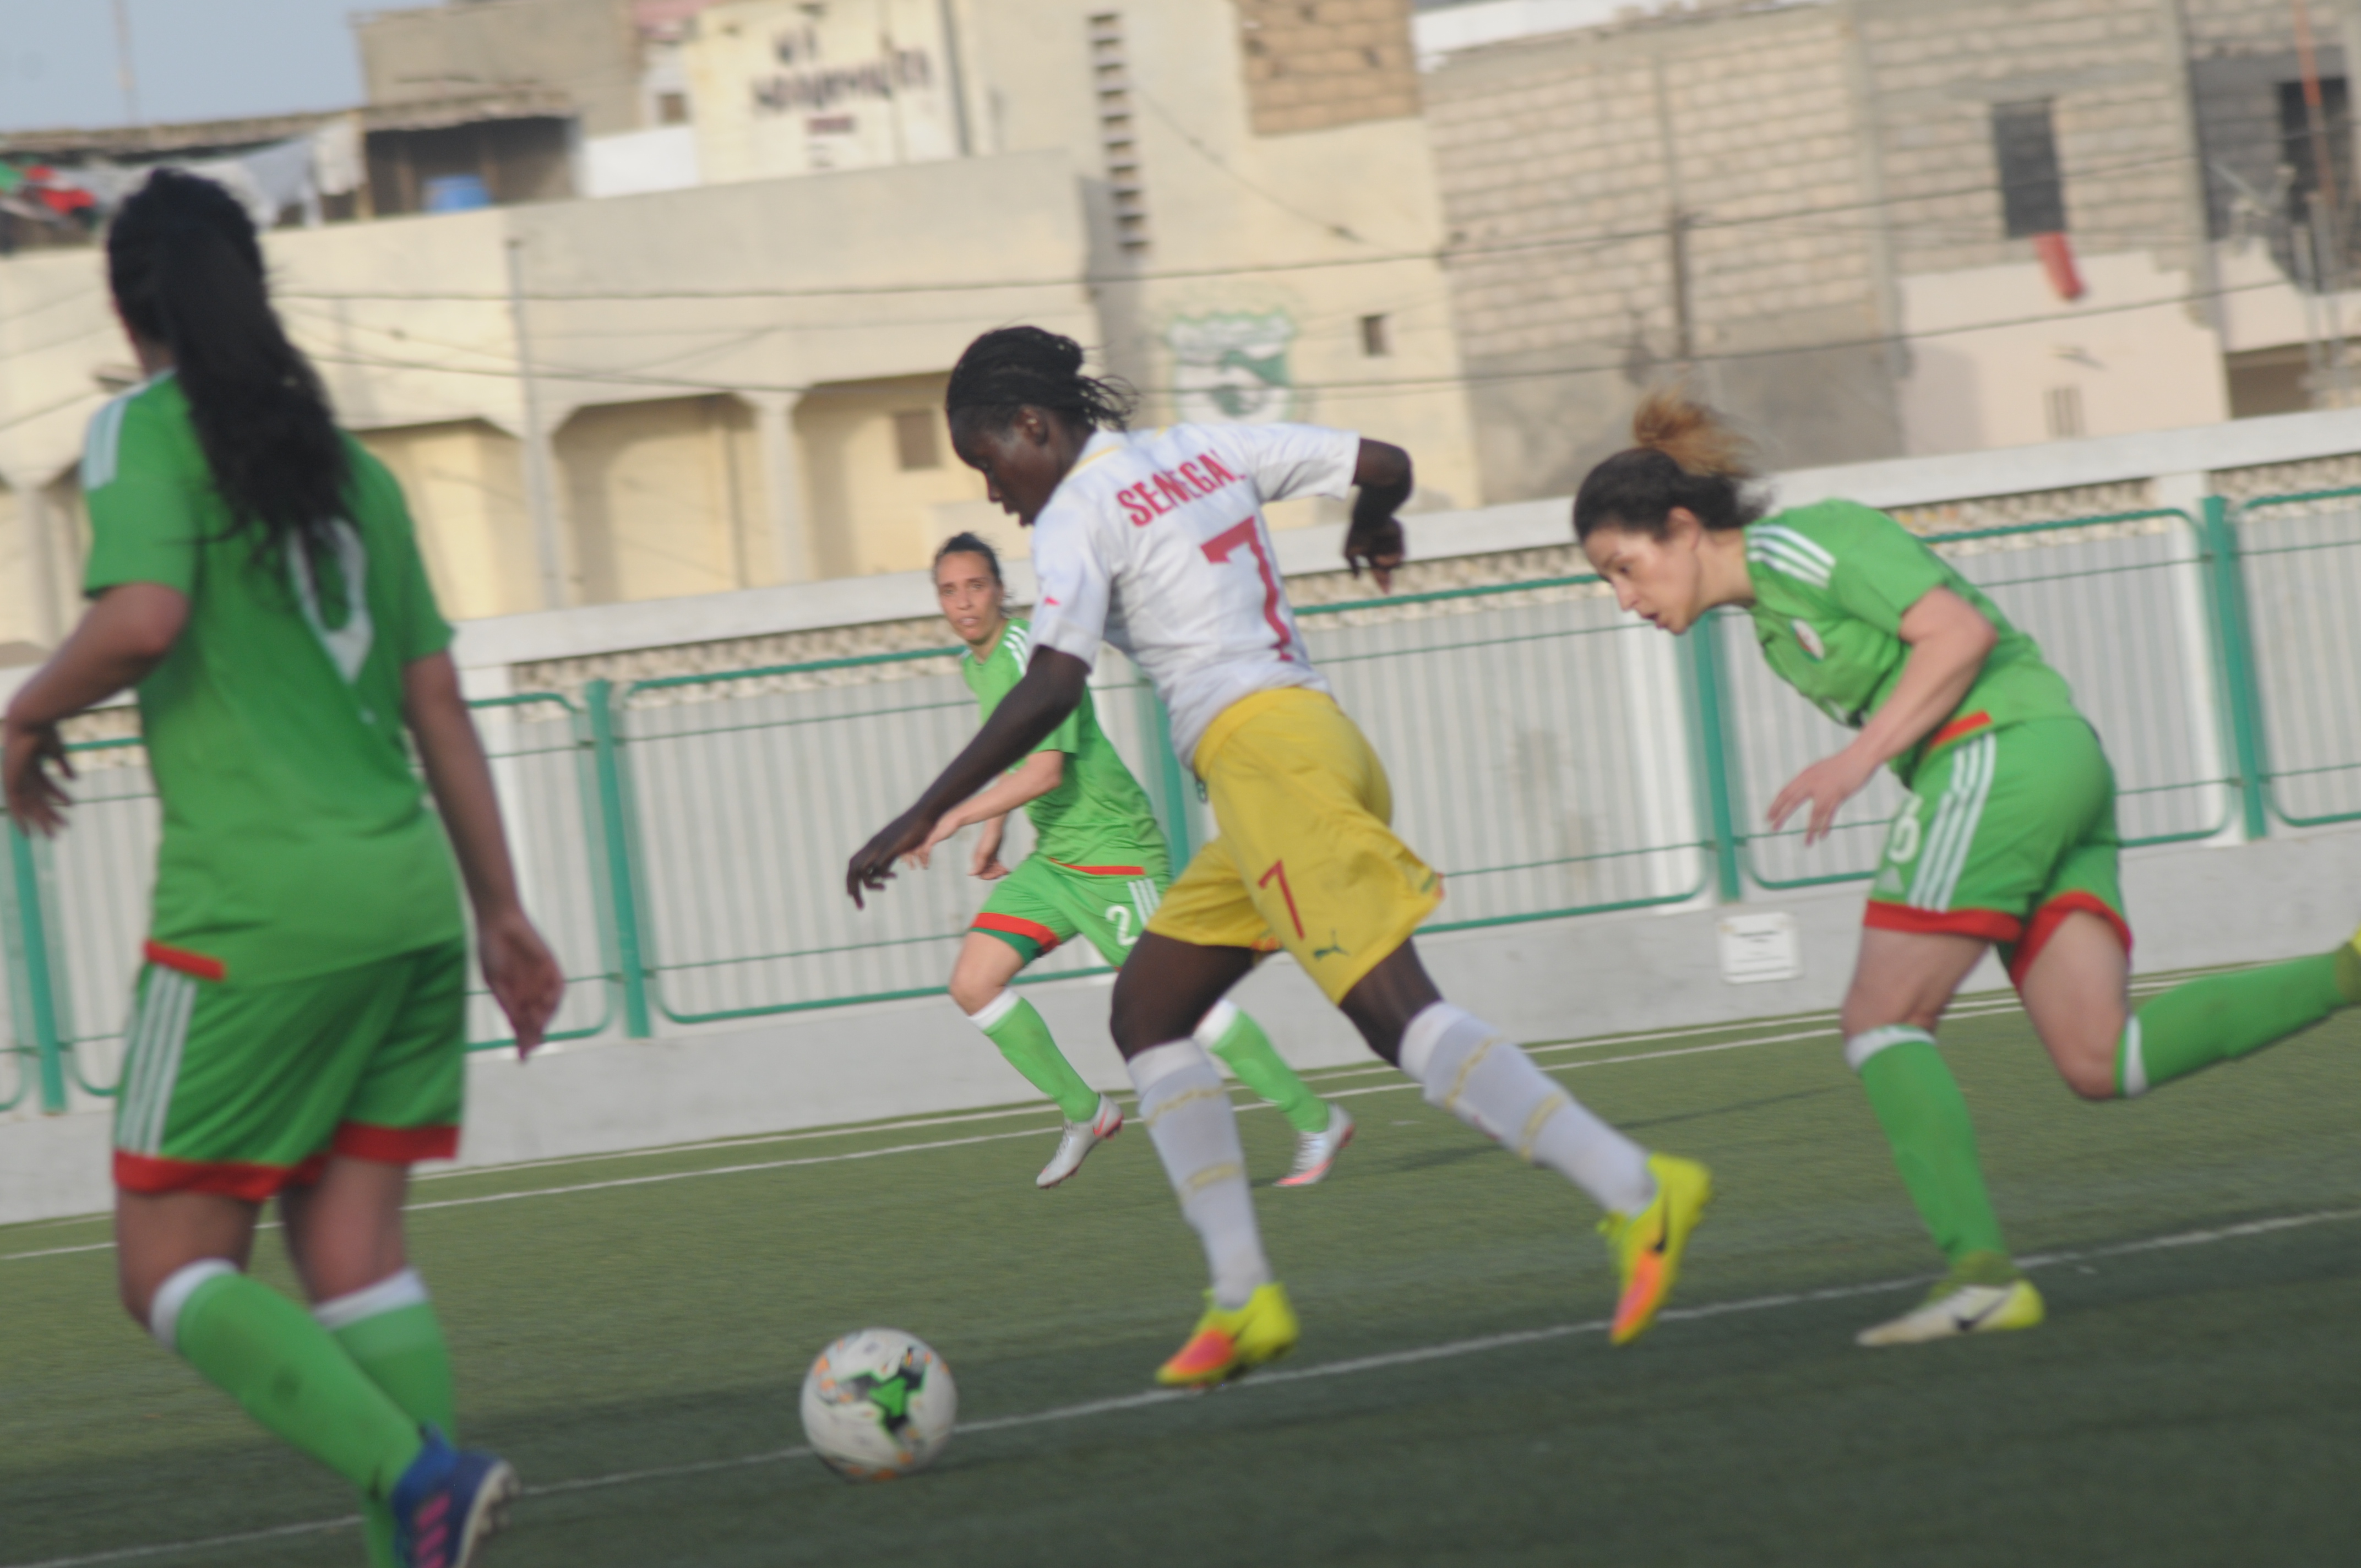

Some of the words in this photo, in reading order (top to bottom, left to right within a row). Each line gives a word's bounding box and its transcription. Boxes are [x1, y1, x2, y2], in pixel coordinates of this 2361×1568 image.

[1200, 515, 1294, 662] 7
[1105, 905, 1140, 946] 2
[1258, 859, 1305, 941] 7
